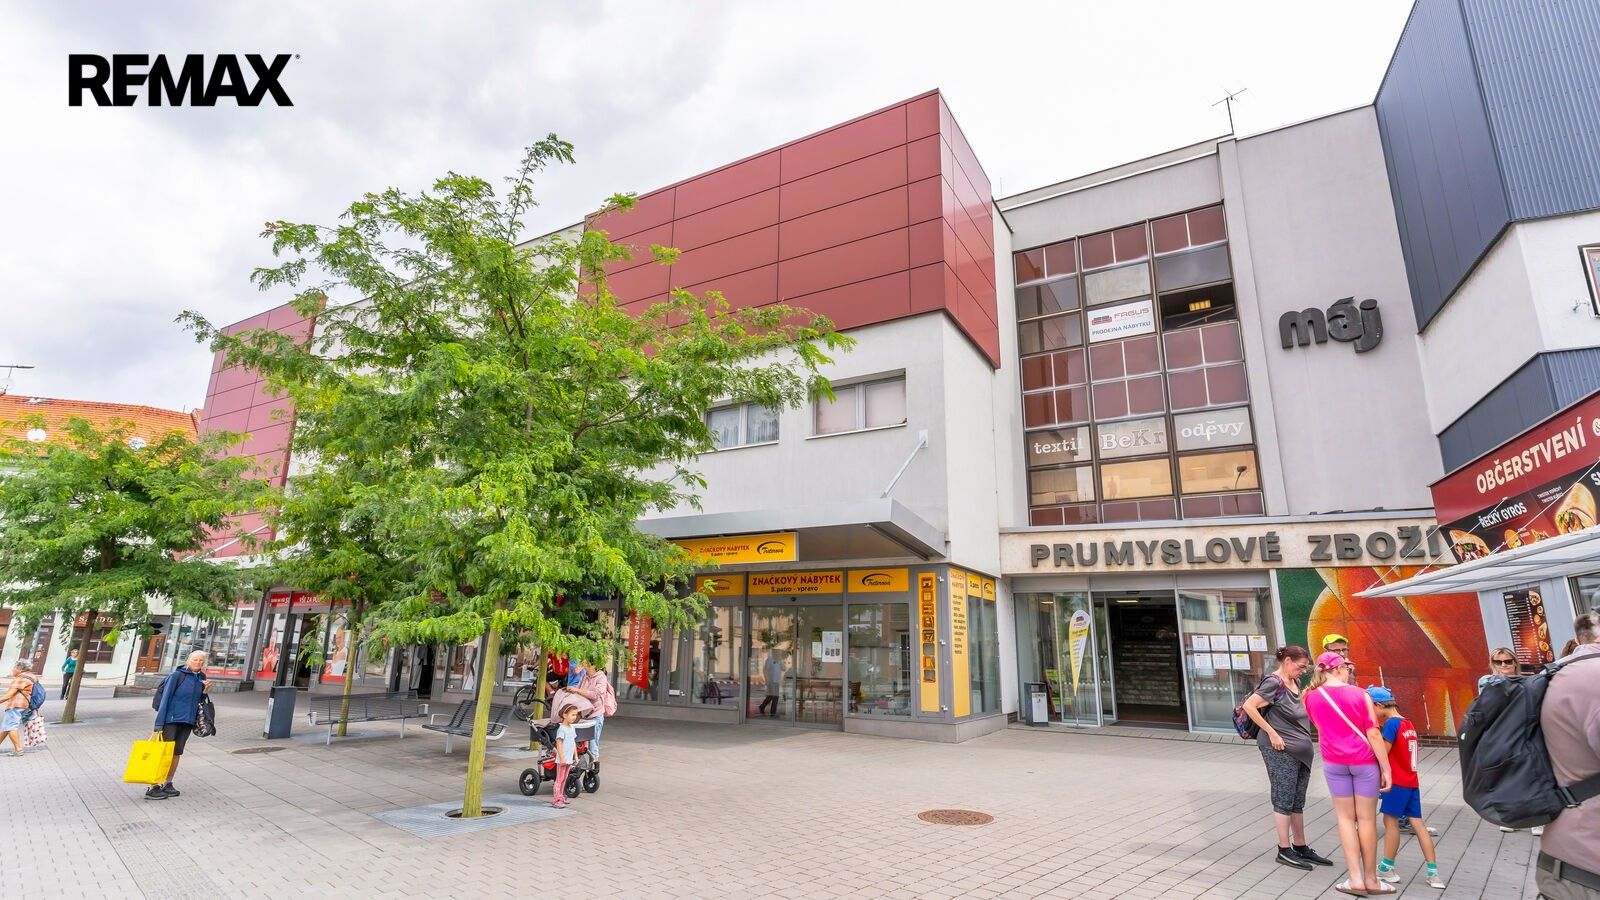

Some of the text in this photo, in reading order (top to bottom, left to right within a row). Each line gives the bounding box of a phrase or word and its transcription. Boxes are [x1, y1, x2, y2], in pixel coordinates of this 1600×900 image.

[1114, 307, 1150, 319] FAGUS
[1091, 321, 1151, 336] PRODEJNA NÁBYTKU
[1279, 296, 1384, 354] máj
[1181, 420, 1245, 439] oděvy
[1034, 436, 1083, 455] textil
[1476, 416, 1587, 494] OBČERSTVENÍ
[1500, 502, 1528, 520] GYROS
[1308, 524, 1441, 561] ZBOŽÍ
[752, 573, 841, 586] ZNAČKOVÝ NÁBYTEK
[797, 585, 819, 593] vpravo
